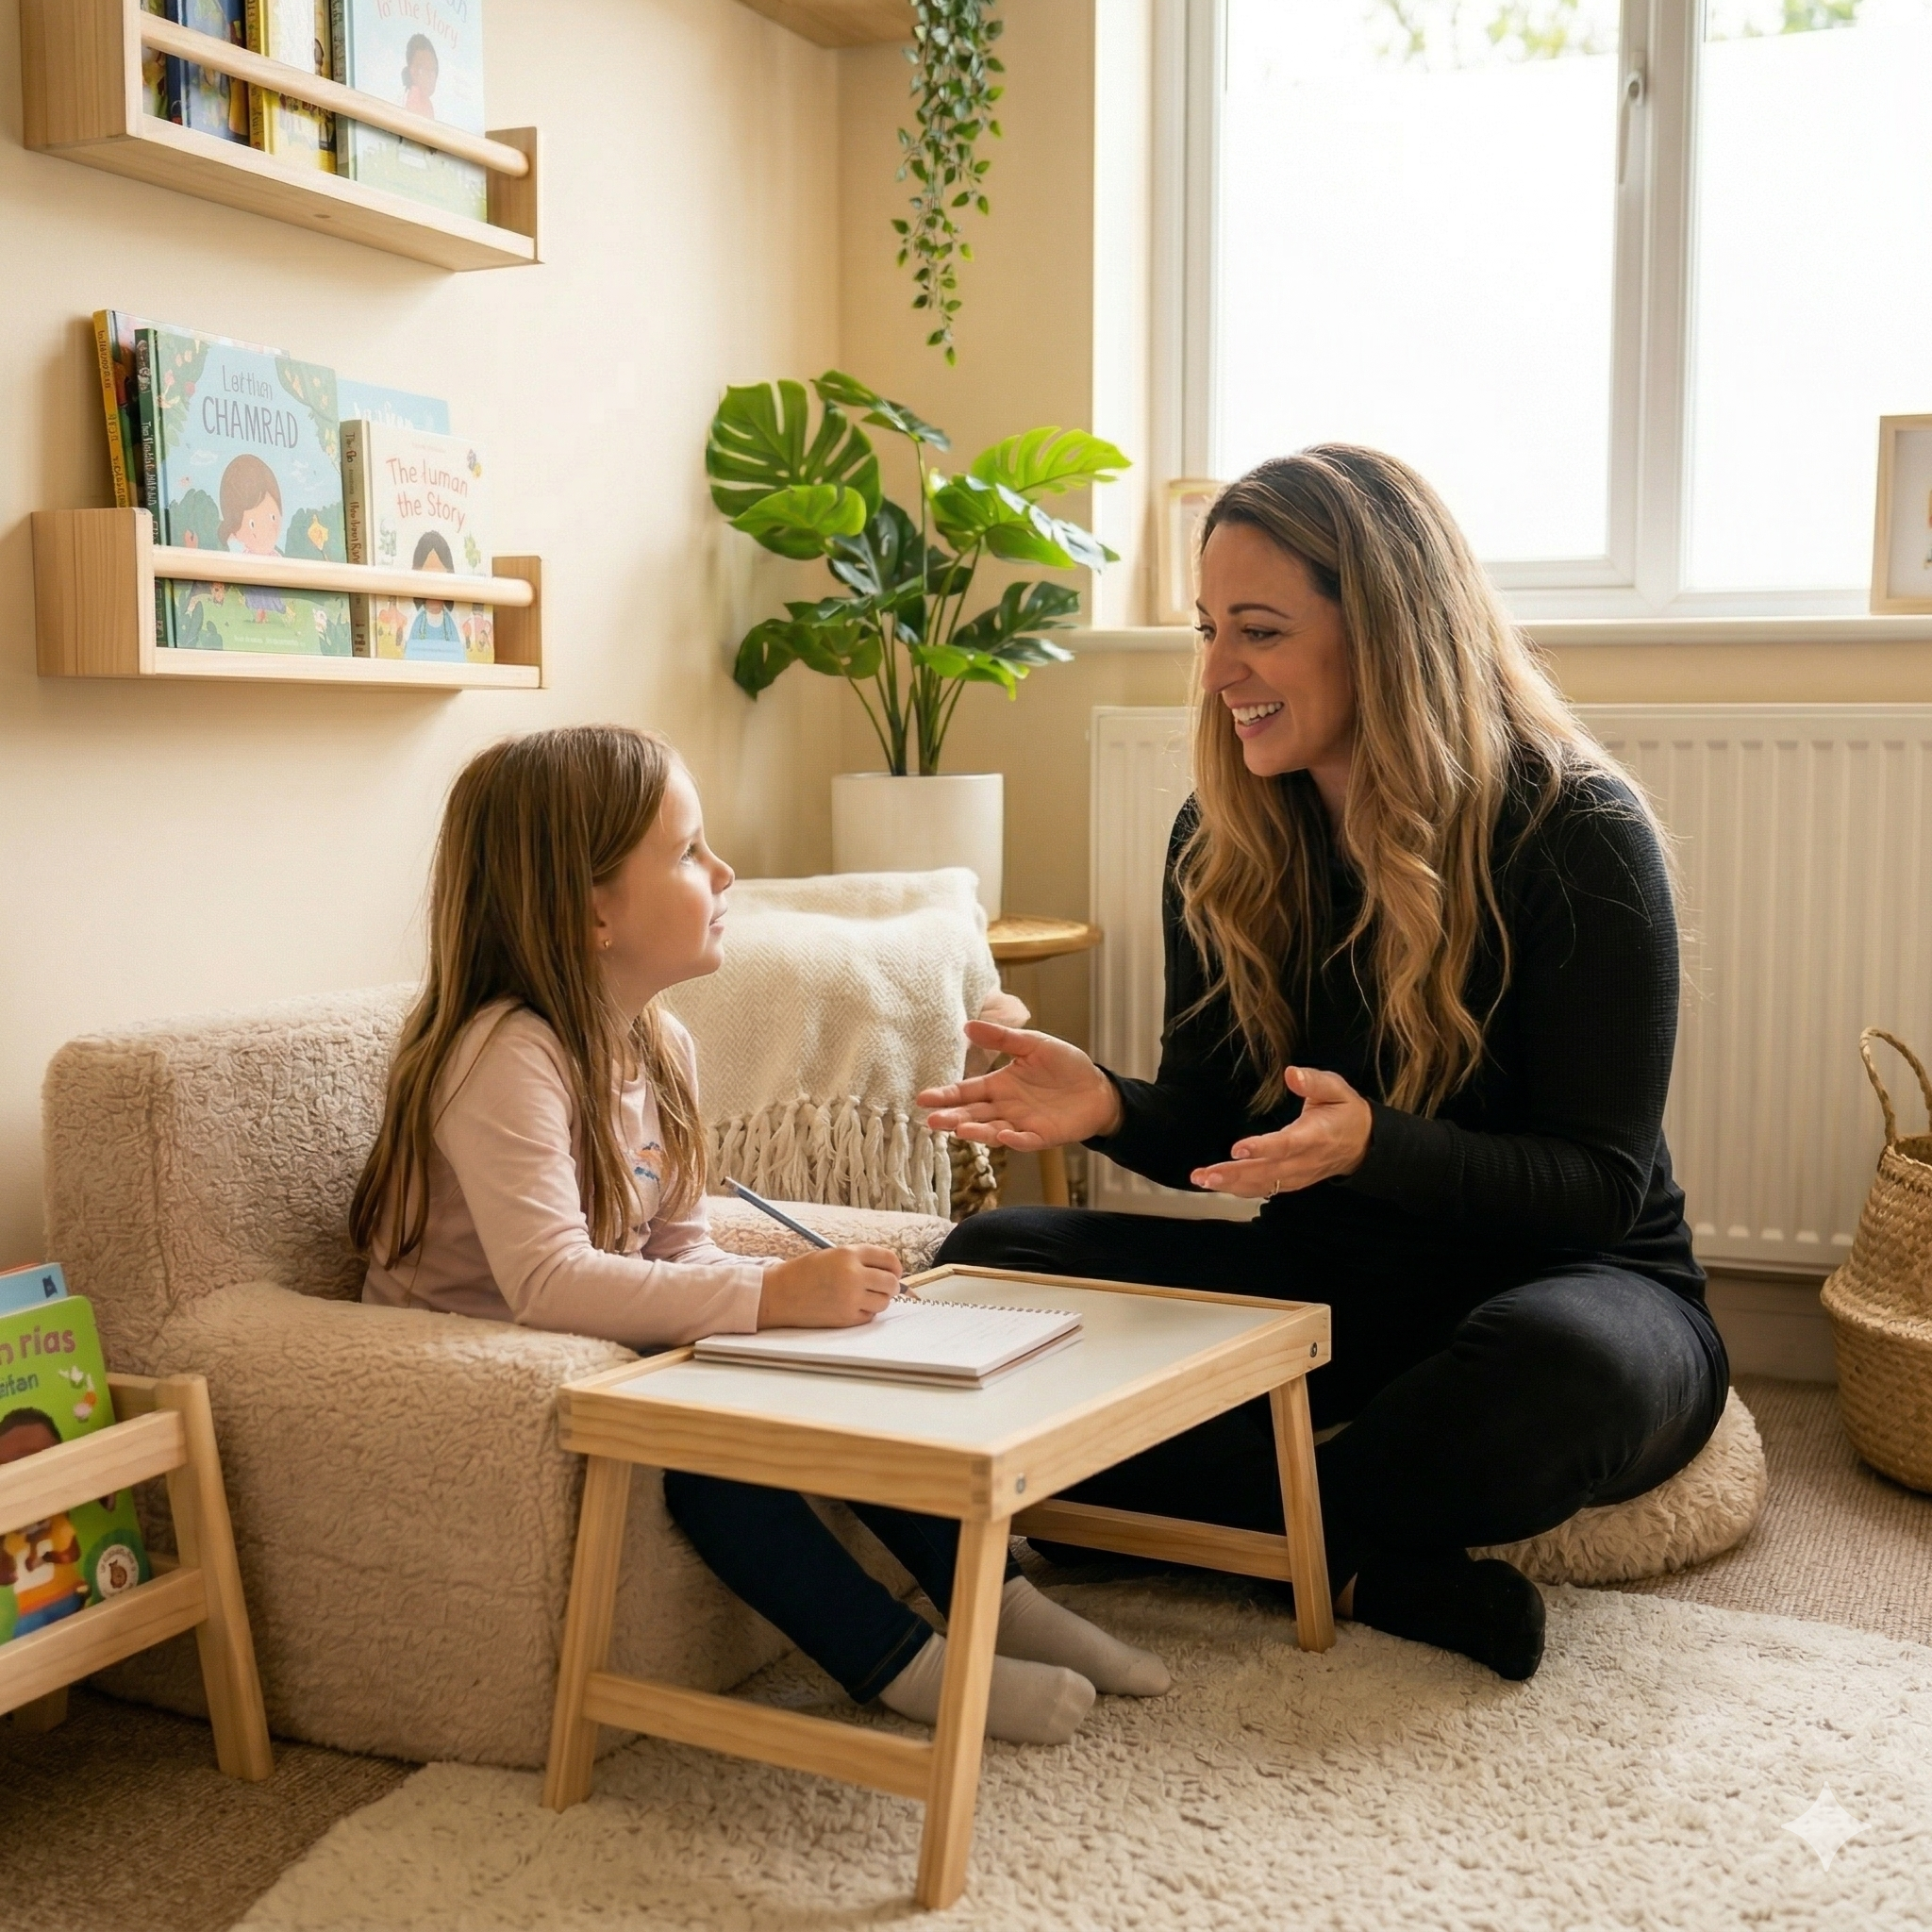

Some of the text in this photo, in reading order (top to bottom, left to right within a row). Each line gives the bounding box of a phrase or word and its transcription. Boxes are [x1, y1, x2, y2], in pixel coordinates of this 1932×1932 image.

[202, 395, 299, 449] CHAMRAD
[386, 458, 418, 486] The
[397, 491, 466, 534] the Story
